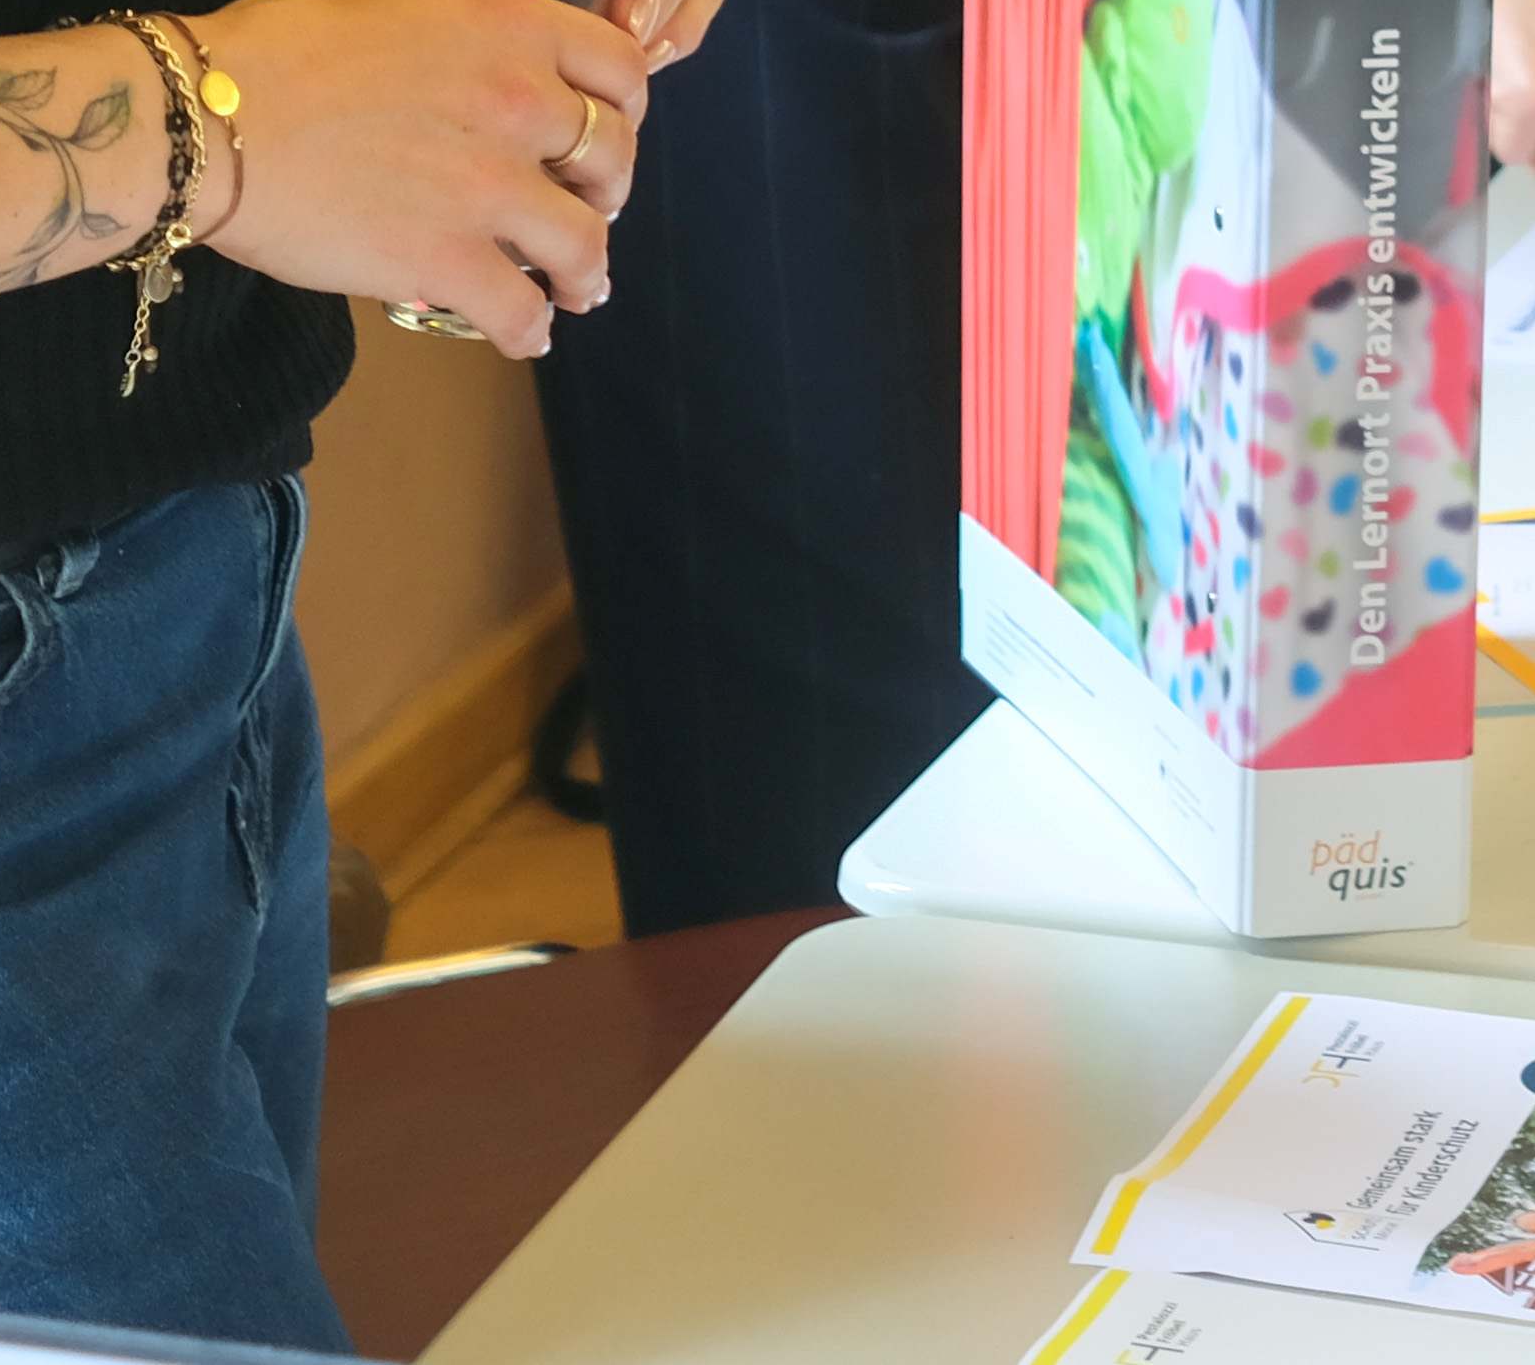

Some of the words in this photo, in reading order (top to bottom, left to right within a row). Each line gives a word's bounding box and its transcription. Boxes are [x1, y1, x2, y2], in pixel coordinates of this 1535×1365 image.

[1360, 28, 1401, 263] entwickeln
[1356, 272, 1396, 401] Praxis
[1353, 409, 1391, 570] Lernort
[1350, 582, 1388, 666] Den
[1310, 829, 1382, 876] päd
[1328, 857, 1407, 902] quis
[1345, 1144, 1418, 1211] Gemeinsam
[1403, 1109, 1443, 1145] stark
[1401, 1118, 1480, 1202] Kinderschutz
[1385, 1201, 1420, 1217] für
